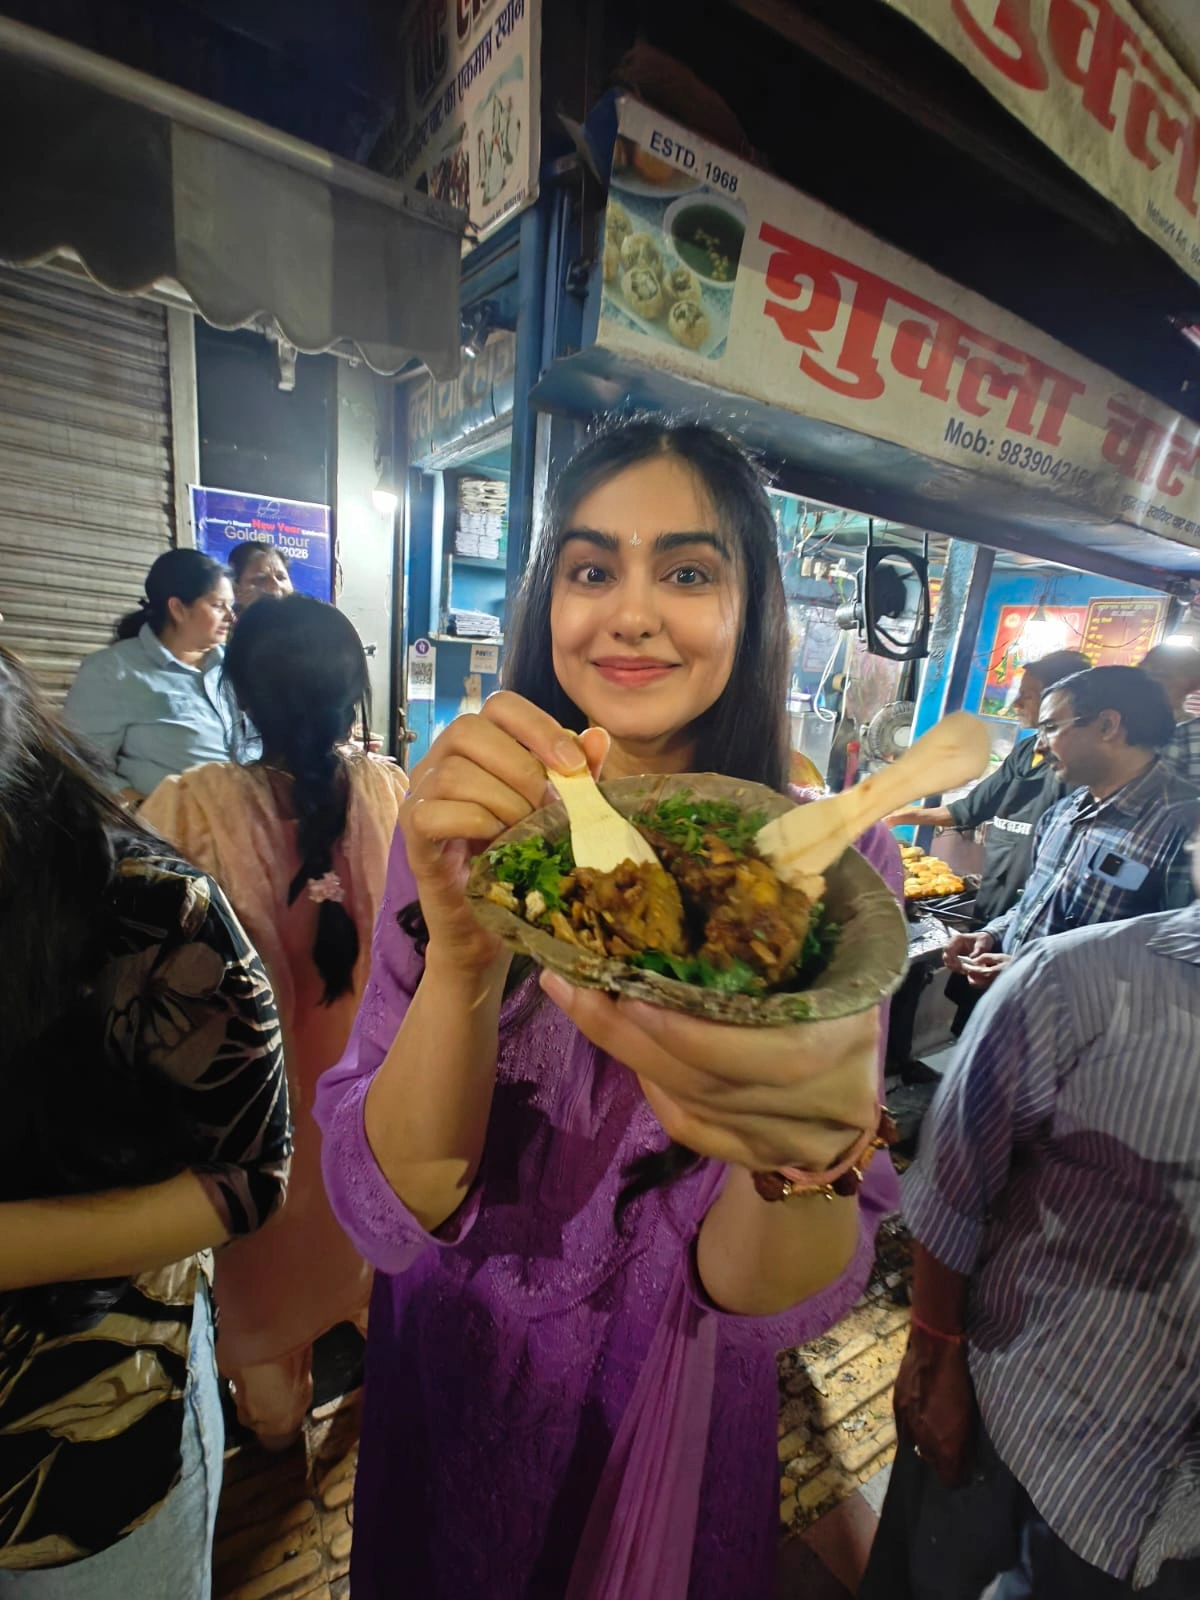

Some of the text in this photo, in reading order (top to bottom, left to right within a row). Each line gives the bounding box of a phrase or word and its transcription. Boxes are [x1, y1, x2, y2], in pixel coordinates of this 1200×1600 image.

[457, 27, 493, 102] एकमात्र
[495, 0, 526, 50] स्थान
[650, 130, 739, 193] ESTD. 1968
[758, 221, 1086, 447] शुक्ला
[943, 417, 993, 458] Mob:
[224, 525, 310, 549] Golden hour
[251, 519, 276, 531] New
[276, 523, 302, 534] Year
